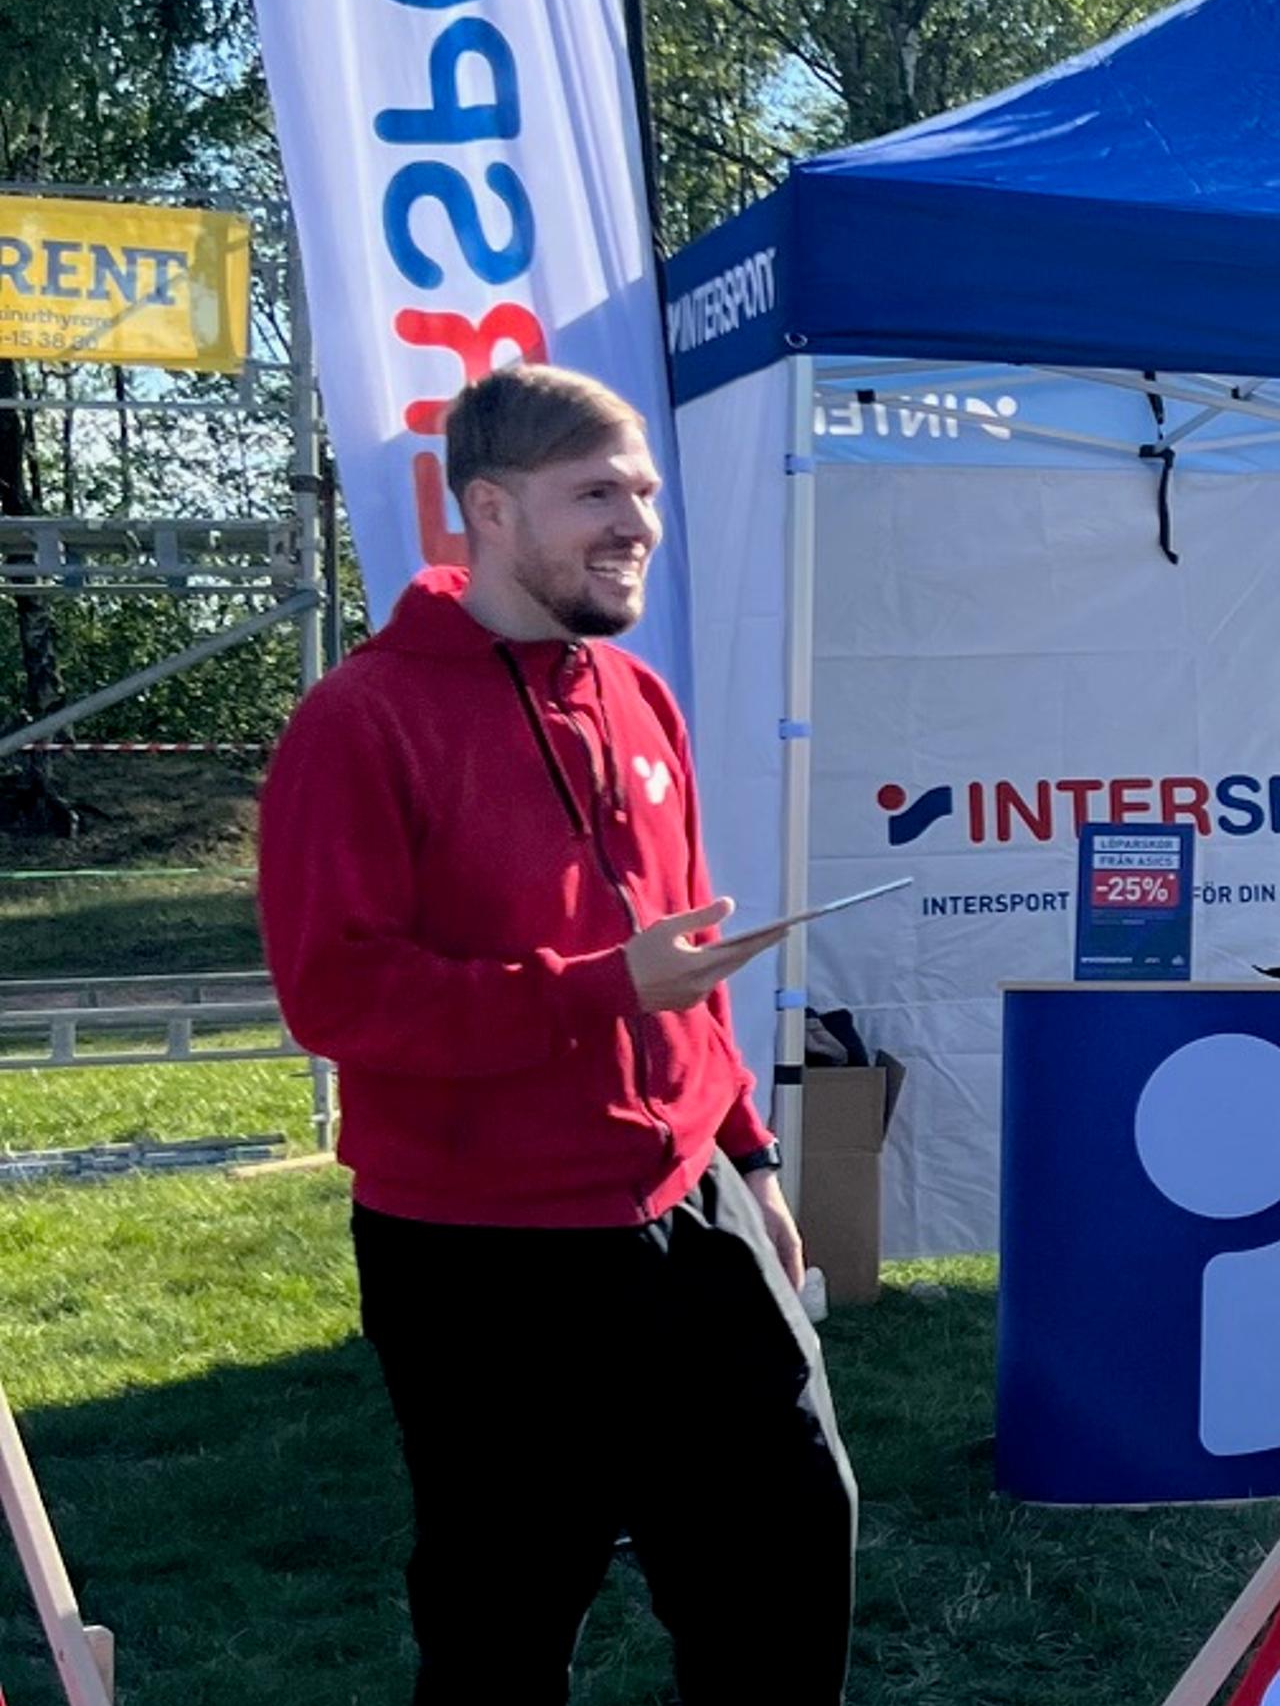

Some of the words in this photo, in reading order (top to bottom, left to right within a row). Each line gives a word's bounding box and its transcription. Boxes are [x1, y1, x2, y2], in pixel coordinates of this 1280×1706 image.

[0, 236, 188, 306] RENT
[679, 246, 776, 353] INTERSPORT
[922, 890, 1069, 917] INTERSPORT
[1239, 884, 1275, 903] DIN
